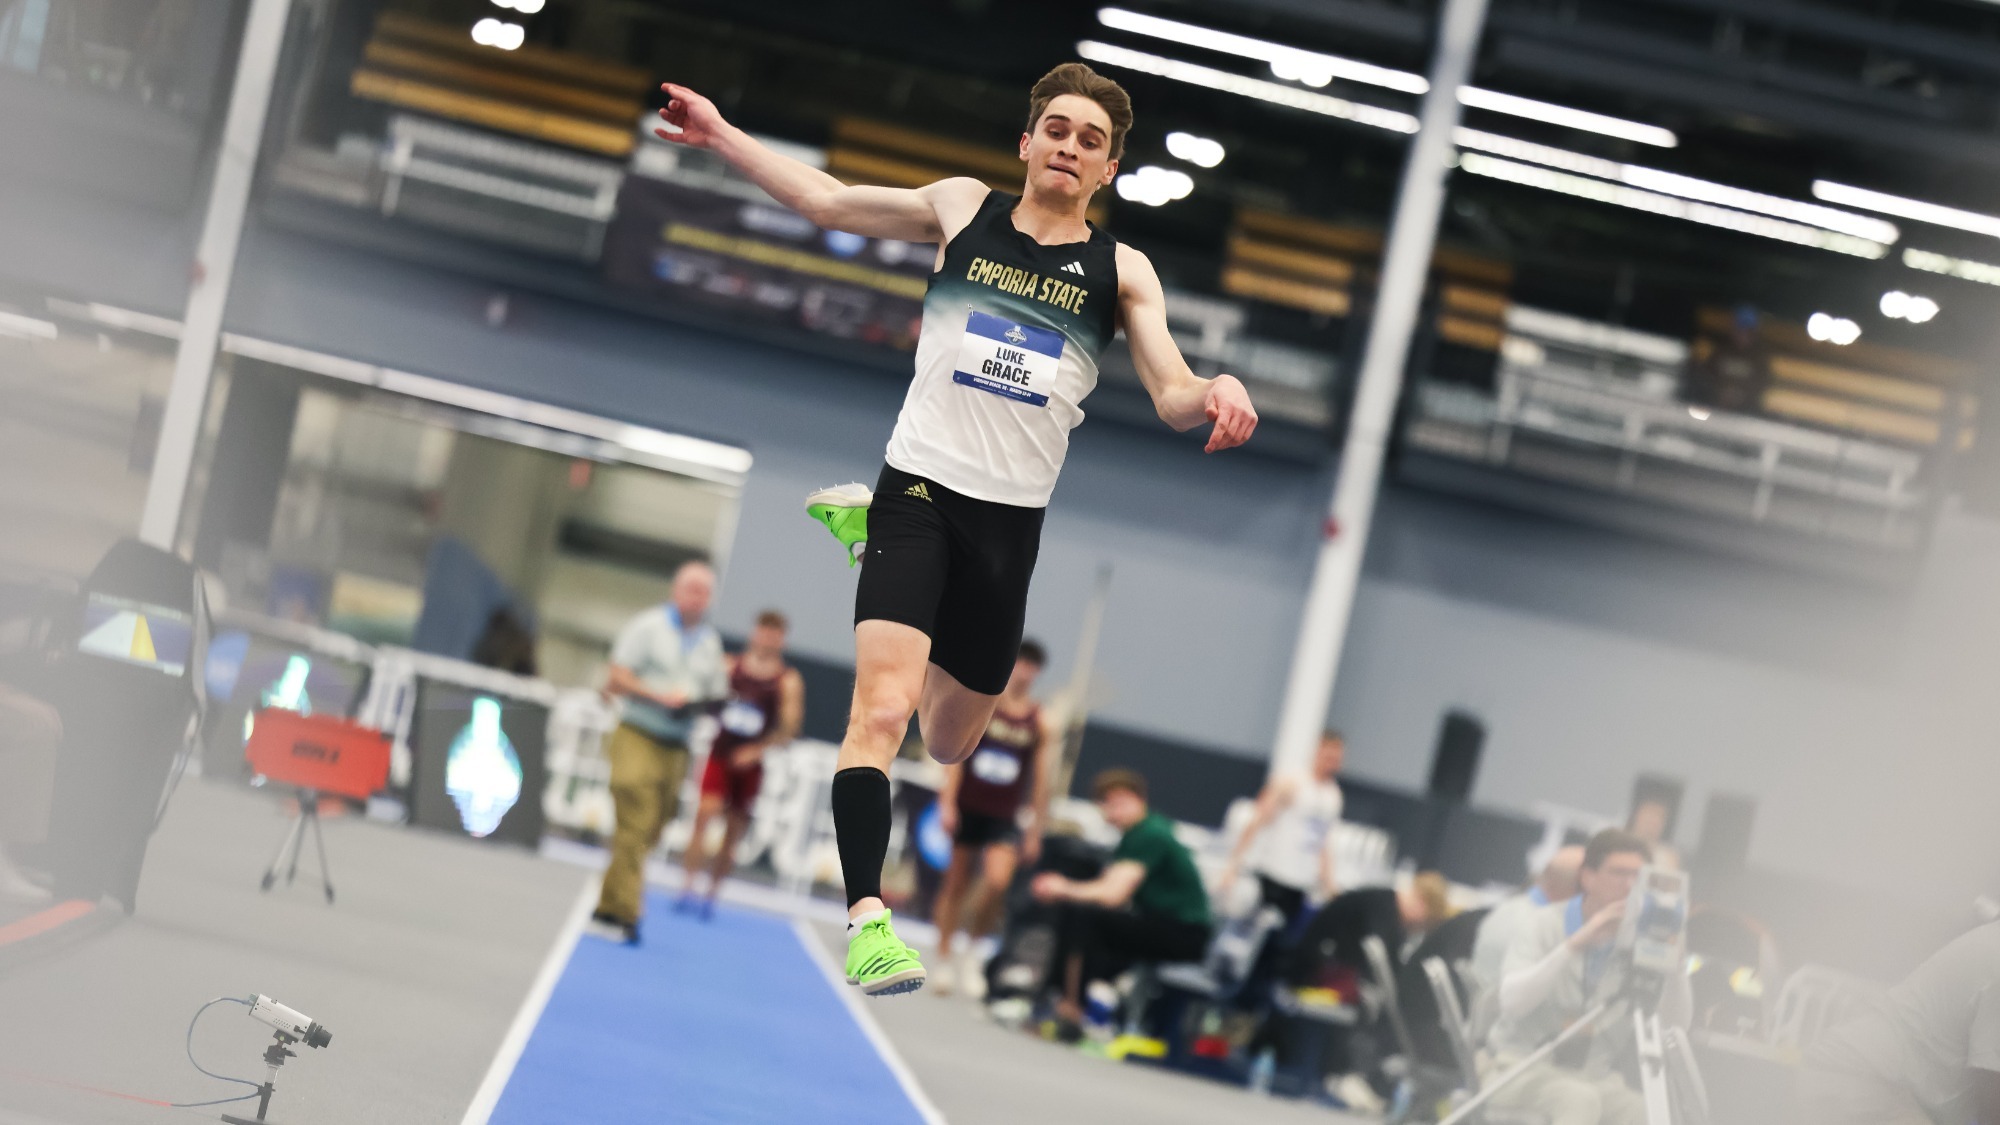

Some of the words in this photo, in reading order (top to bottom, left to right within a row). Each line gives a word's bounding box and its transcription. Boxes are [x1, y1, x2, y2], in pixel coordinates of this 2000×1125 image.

[966, 257, 1039, 298] EMPORIA
[1037, 277, 1088, 315] STATE
[995, 347, 1026, 365] LUKE
[981, 359, 1032, 386] GRACE
